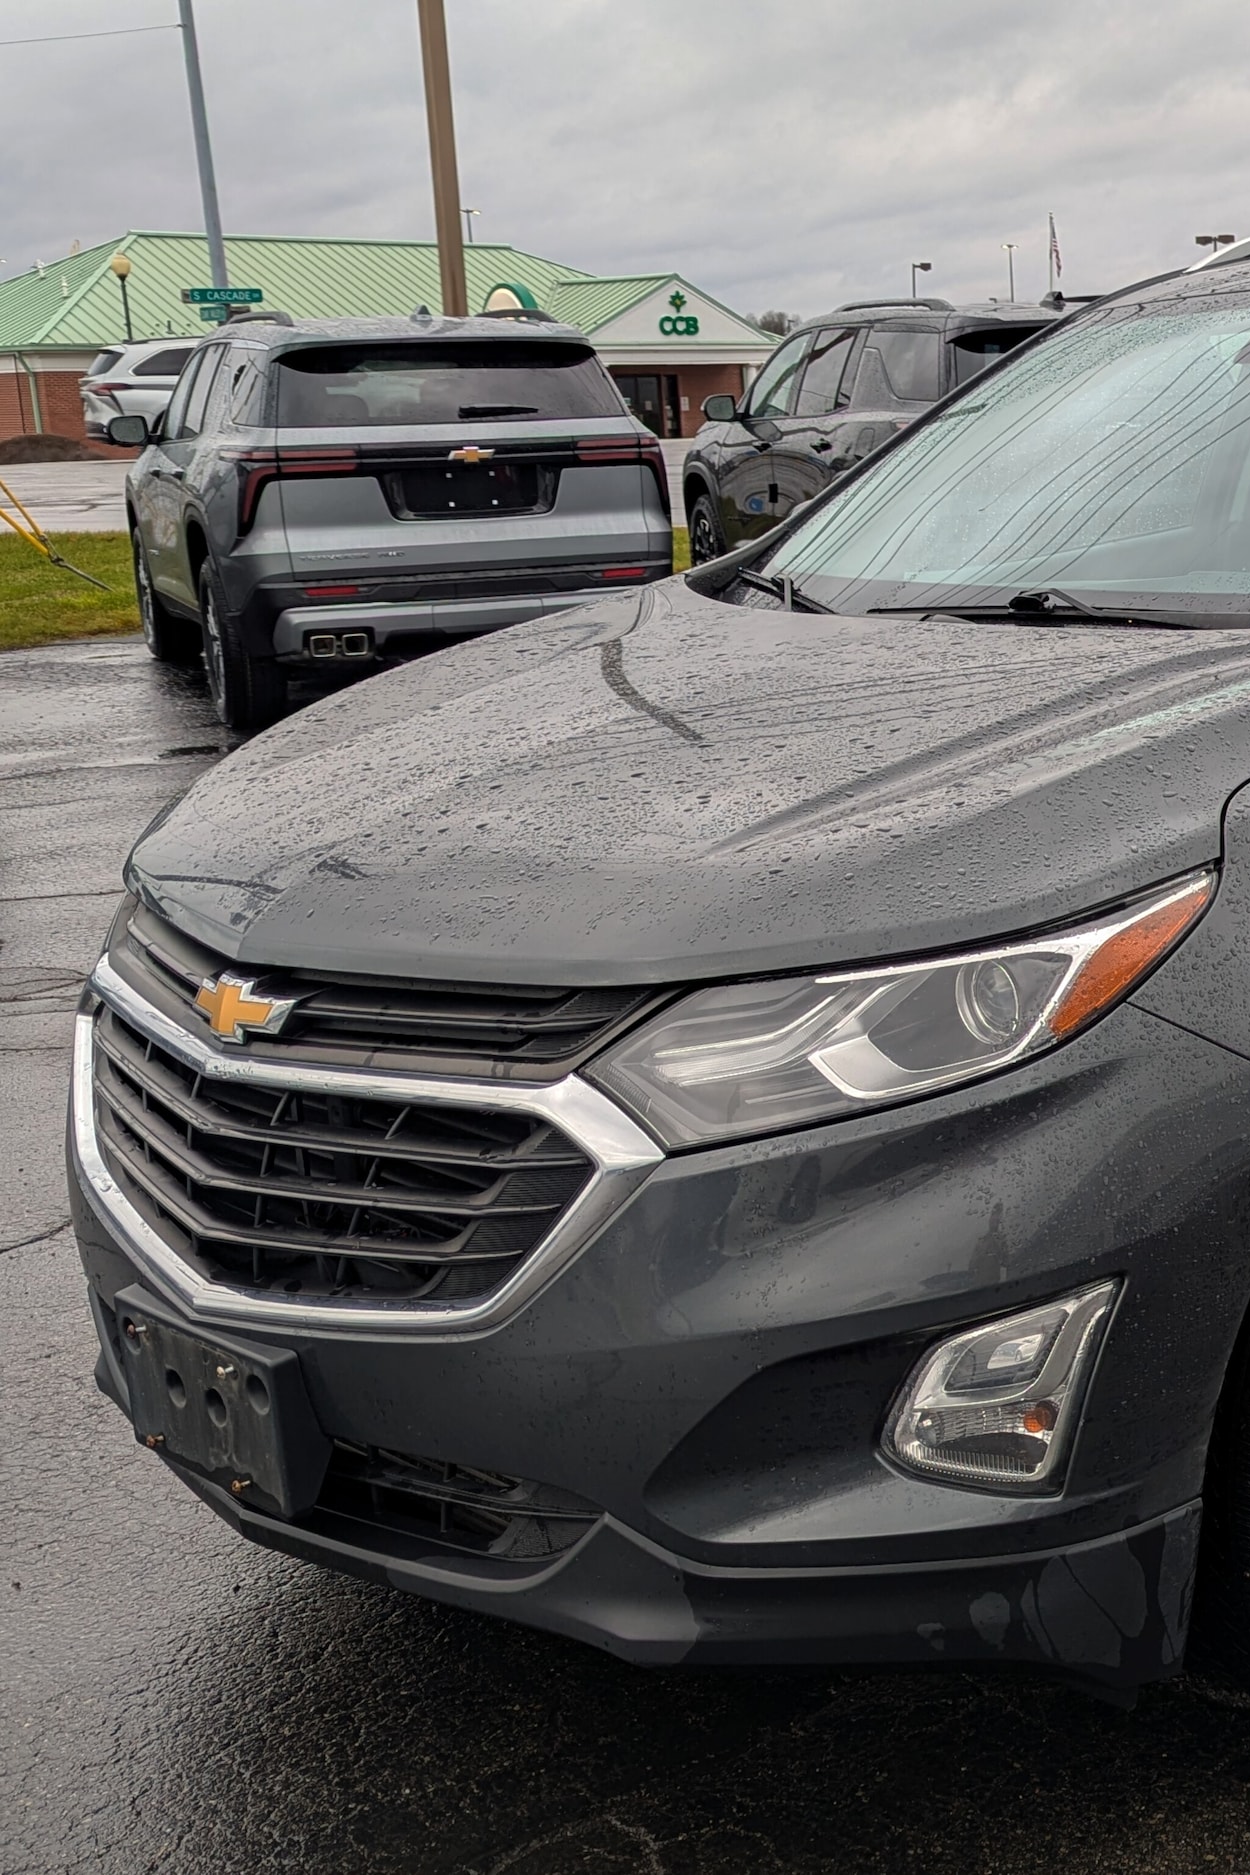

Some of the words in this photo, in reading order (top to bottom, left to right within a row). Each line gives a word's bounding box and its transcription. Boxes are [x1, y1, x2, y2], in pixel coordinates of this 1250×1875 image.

[193, 291, 200, 300] S
[207, 291, 251, 300] CASCADE
[658, 315, 700, 336] CCB
